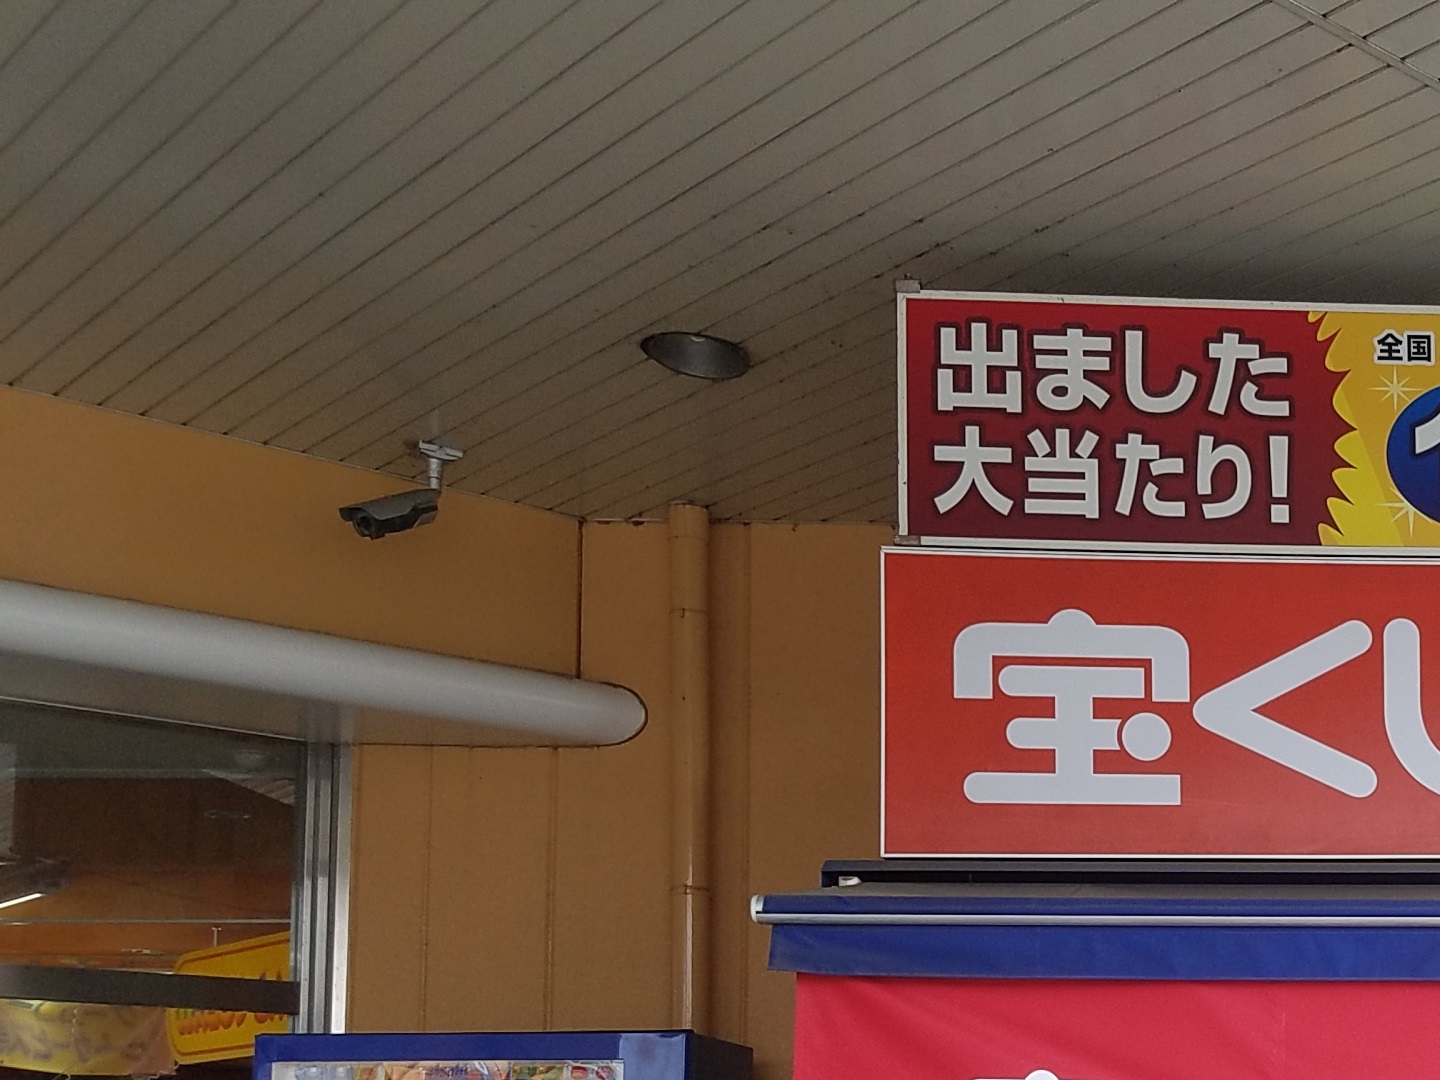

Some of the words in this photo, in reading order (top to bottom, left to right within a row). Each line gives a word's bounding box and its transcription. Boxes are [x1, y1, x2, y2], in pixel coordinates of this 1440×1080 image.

[936, 321, 1291, 417] 出ました
[1376, 332, 1433, 363] 全国
[932, 425, 1291, 524] 大当たり!
